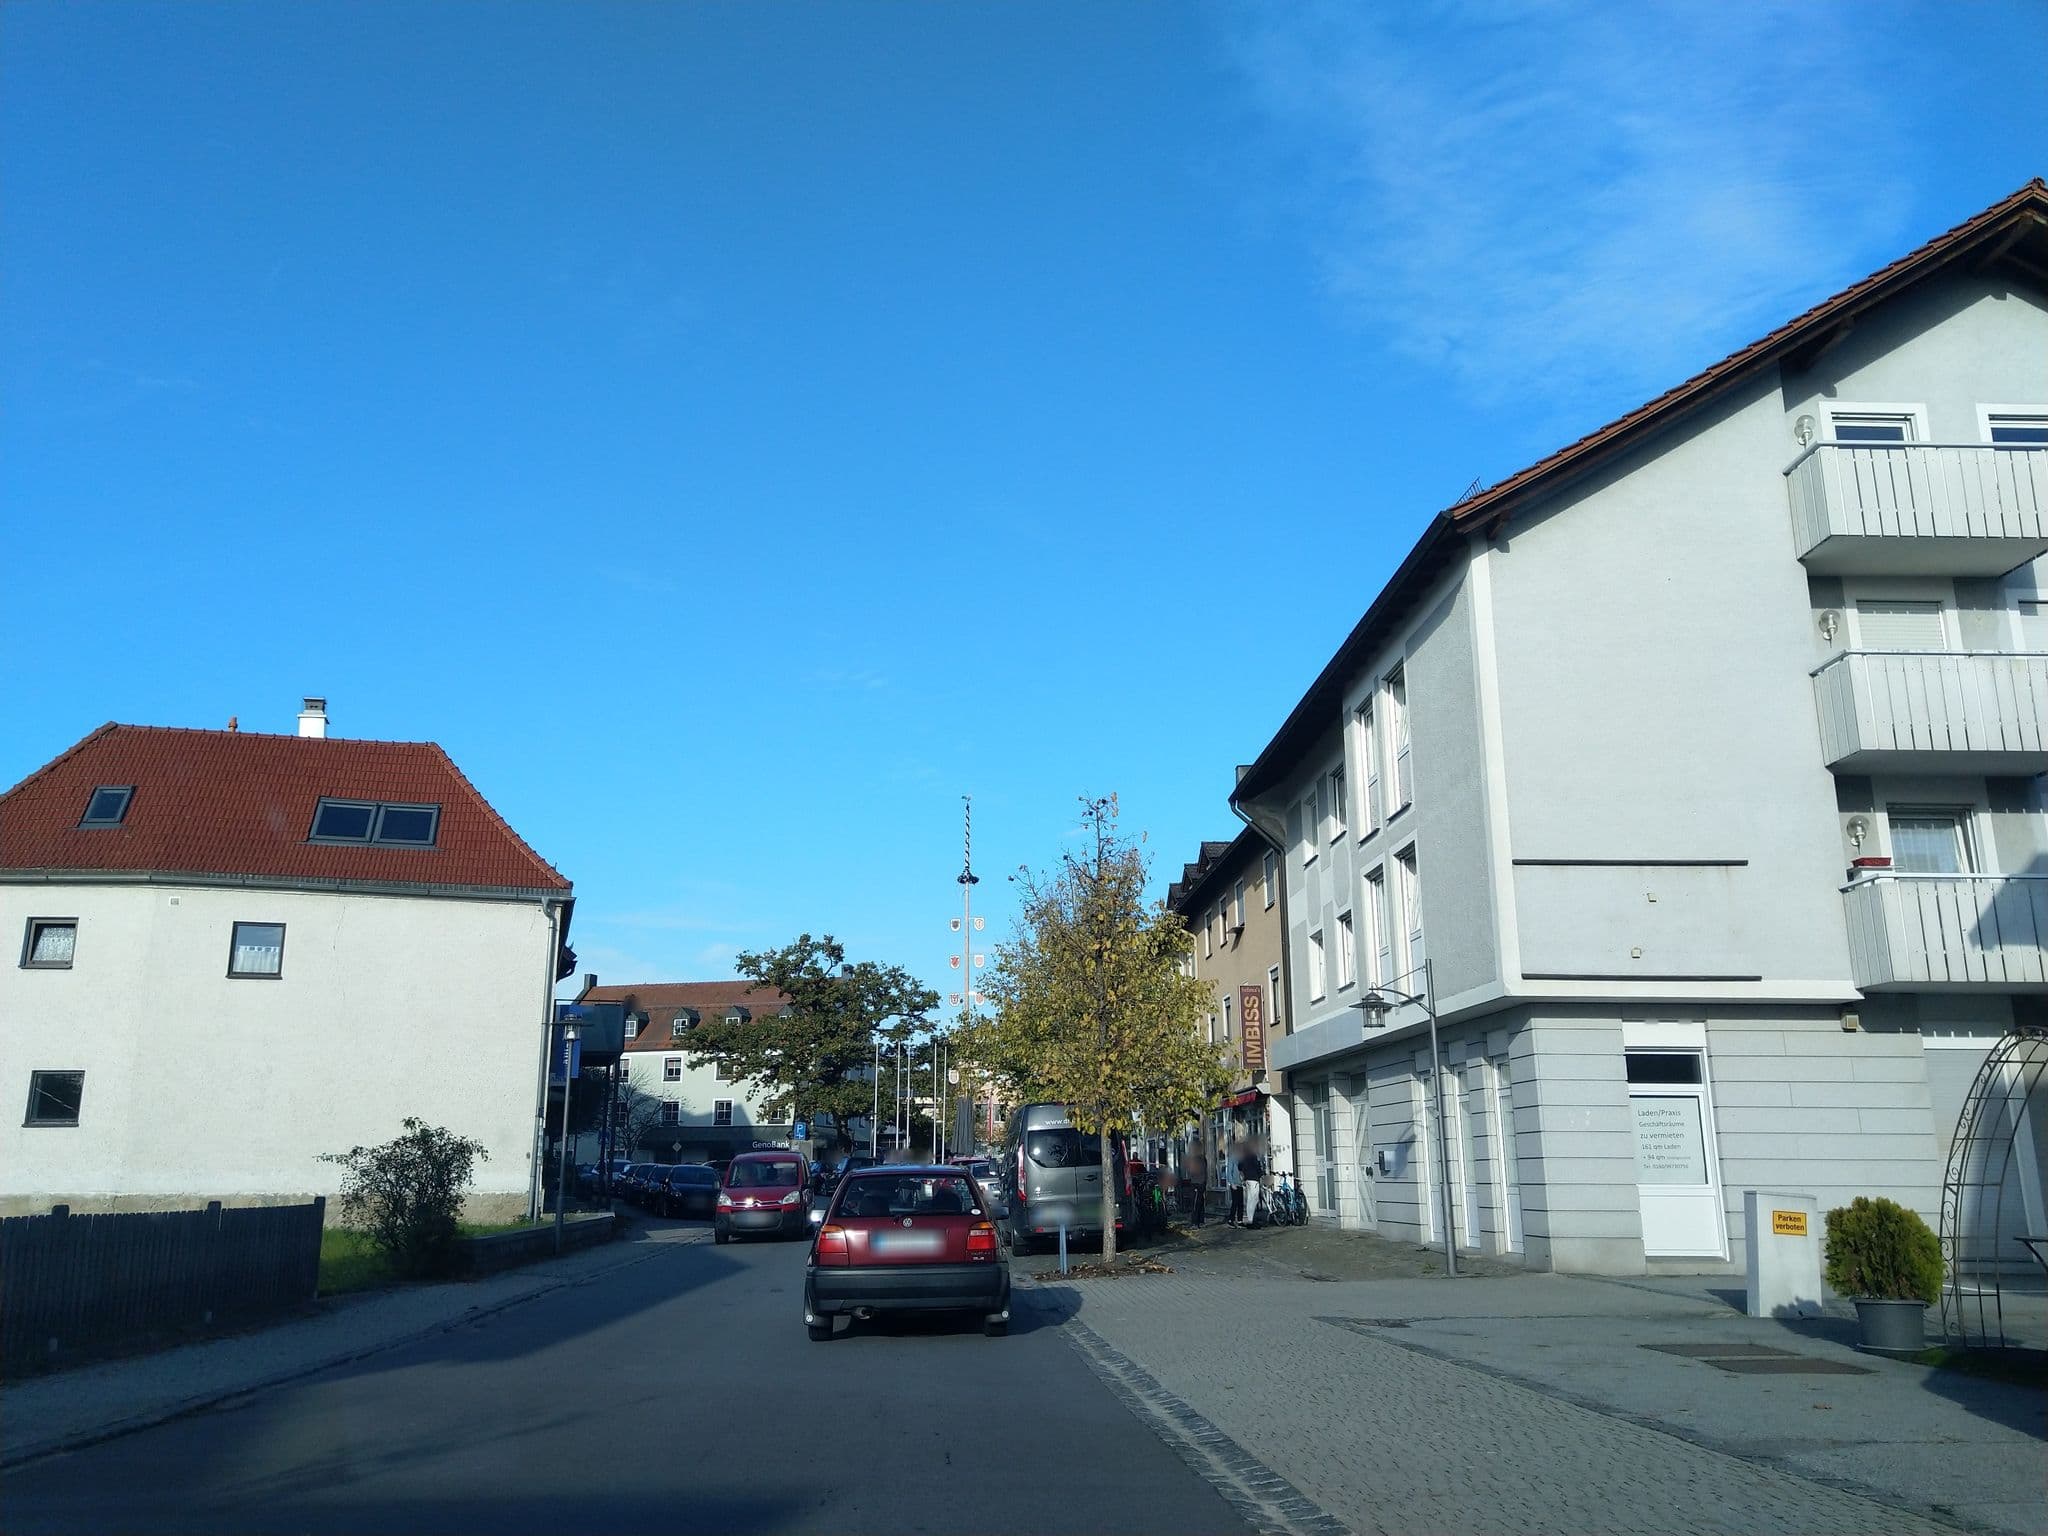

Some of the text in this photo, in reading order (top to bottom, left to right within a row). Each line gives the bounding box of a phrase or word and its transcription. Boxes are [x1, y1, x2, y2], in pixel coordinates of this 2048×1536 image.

[1244, 995, 1261, 1063] IMBISS
[1637, 1109, 1681, 1117] Laden/Praxis
[1650, 1131, 1685, 1139] vermieten
[752, 1140, 790, 1149] GenoBank
[1777, 1214, 1802, 1222] Parken
[1775, 1223, 1805, 1231] verboten
